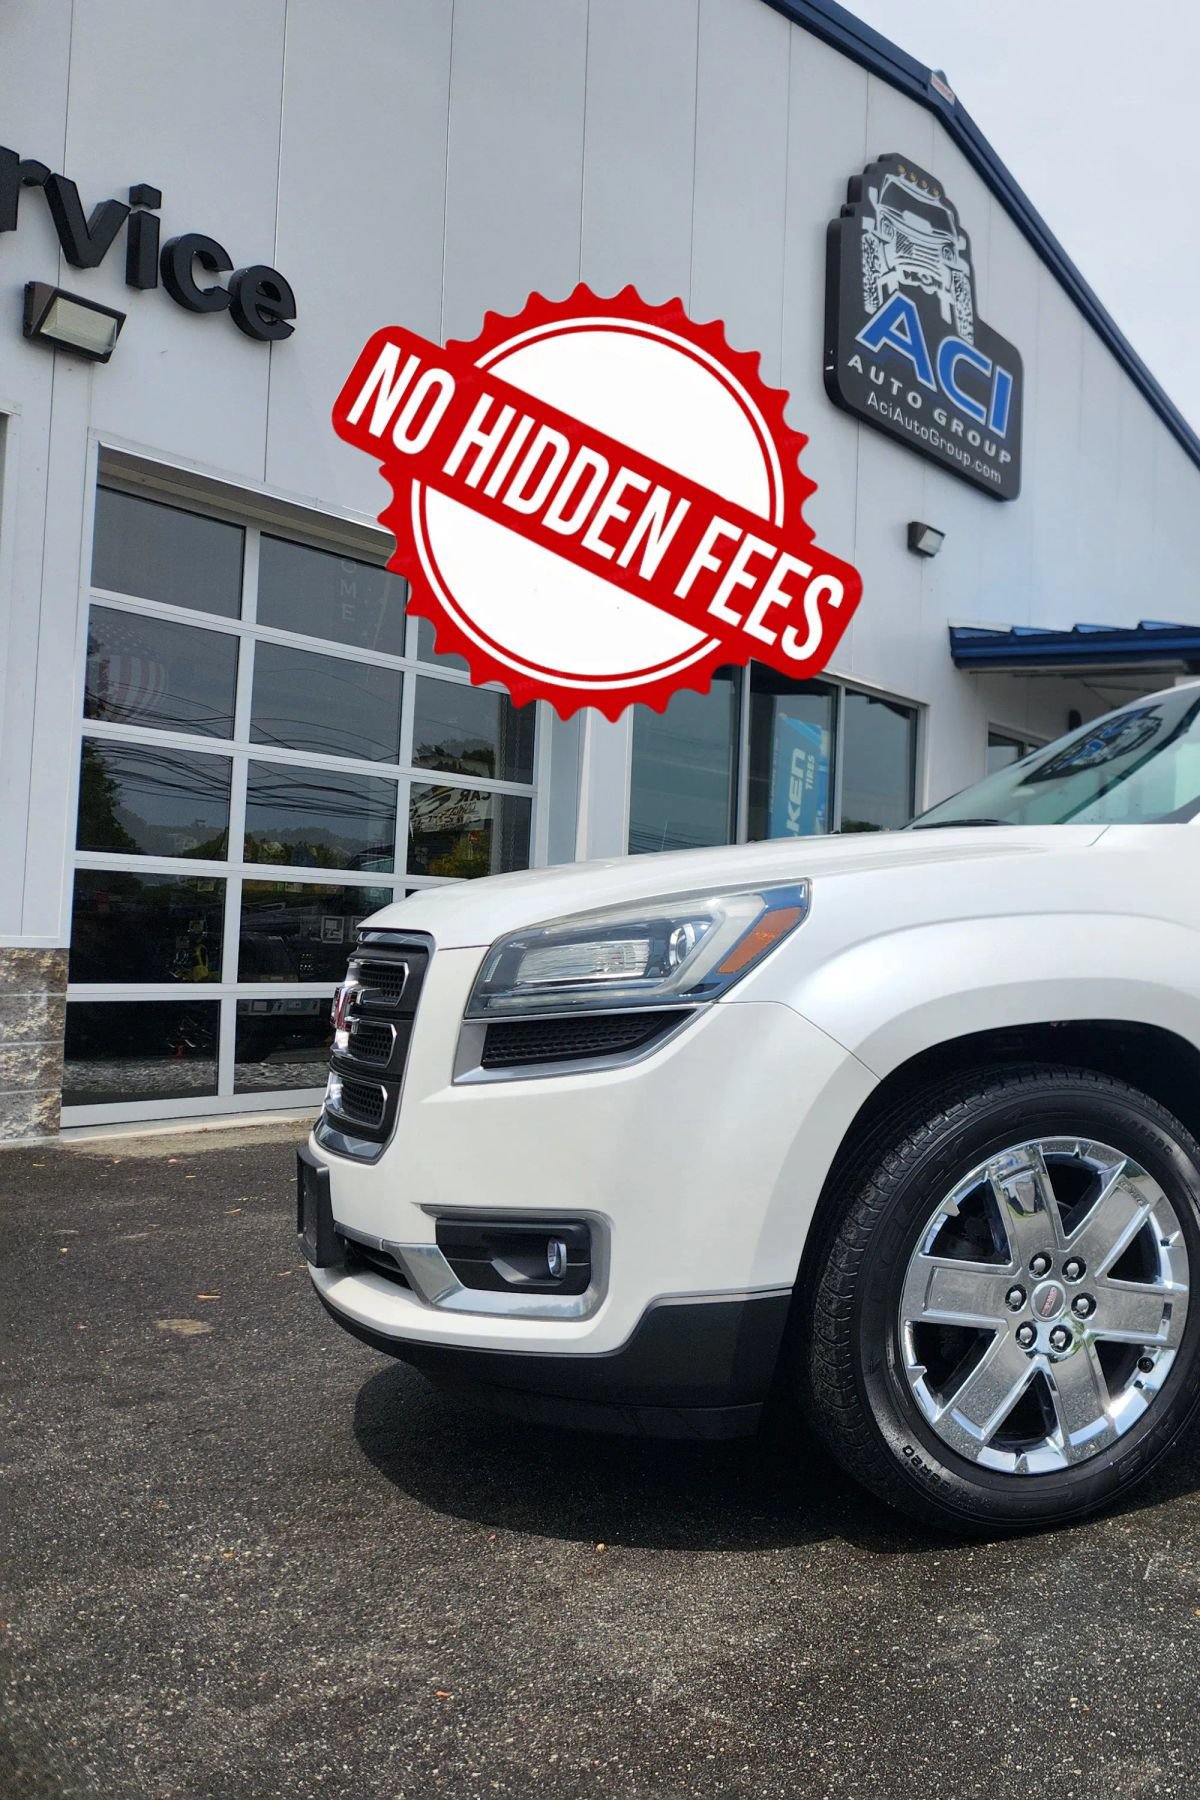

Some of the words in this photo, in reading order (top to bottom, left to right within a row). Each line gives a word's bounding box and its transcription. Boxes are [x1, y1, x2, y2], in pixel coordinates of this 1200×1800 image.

[0, 146, 296, 341] rvice
[848, 355, 923, 410] AUTO
[933, 407, 1012, 465] GROUP
[856, 291, 1013, 438] ACI
[866, 392, 1002, 484] AciAutoGroup.com
[785, 747, 806, 836] KEN
[804, 752, 816, 790] TIRES
